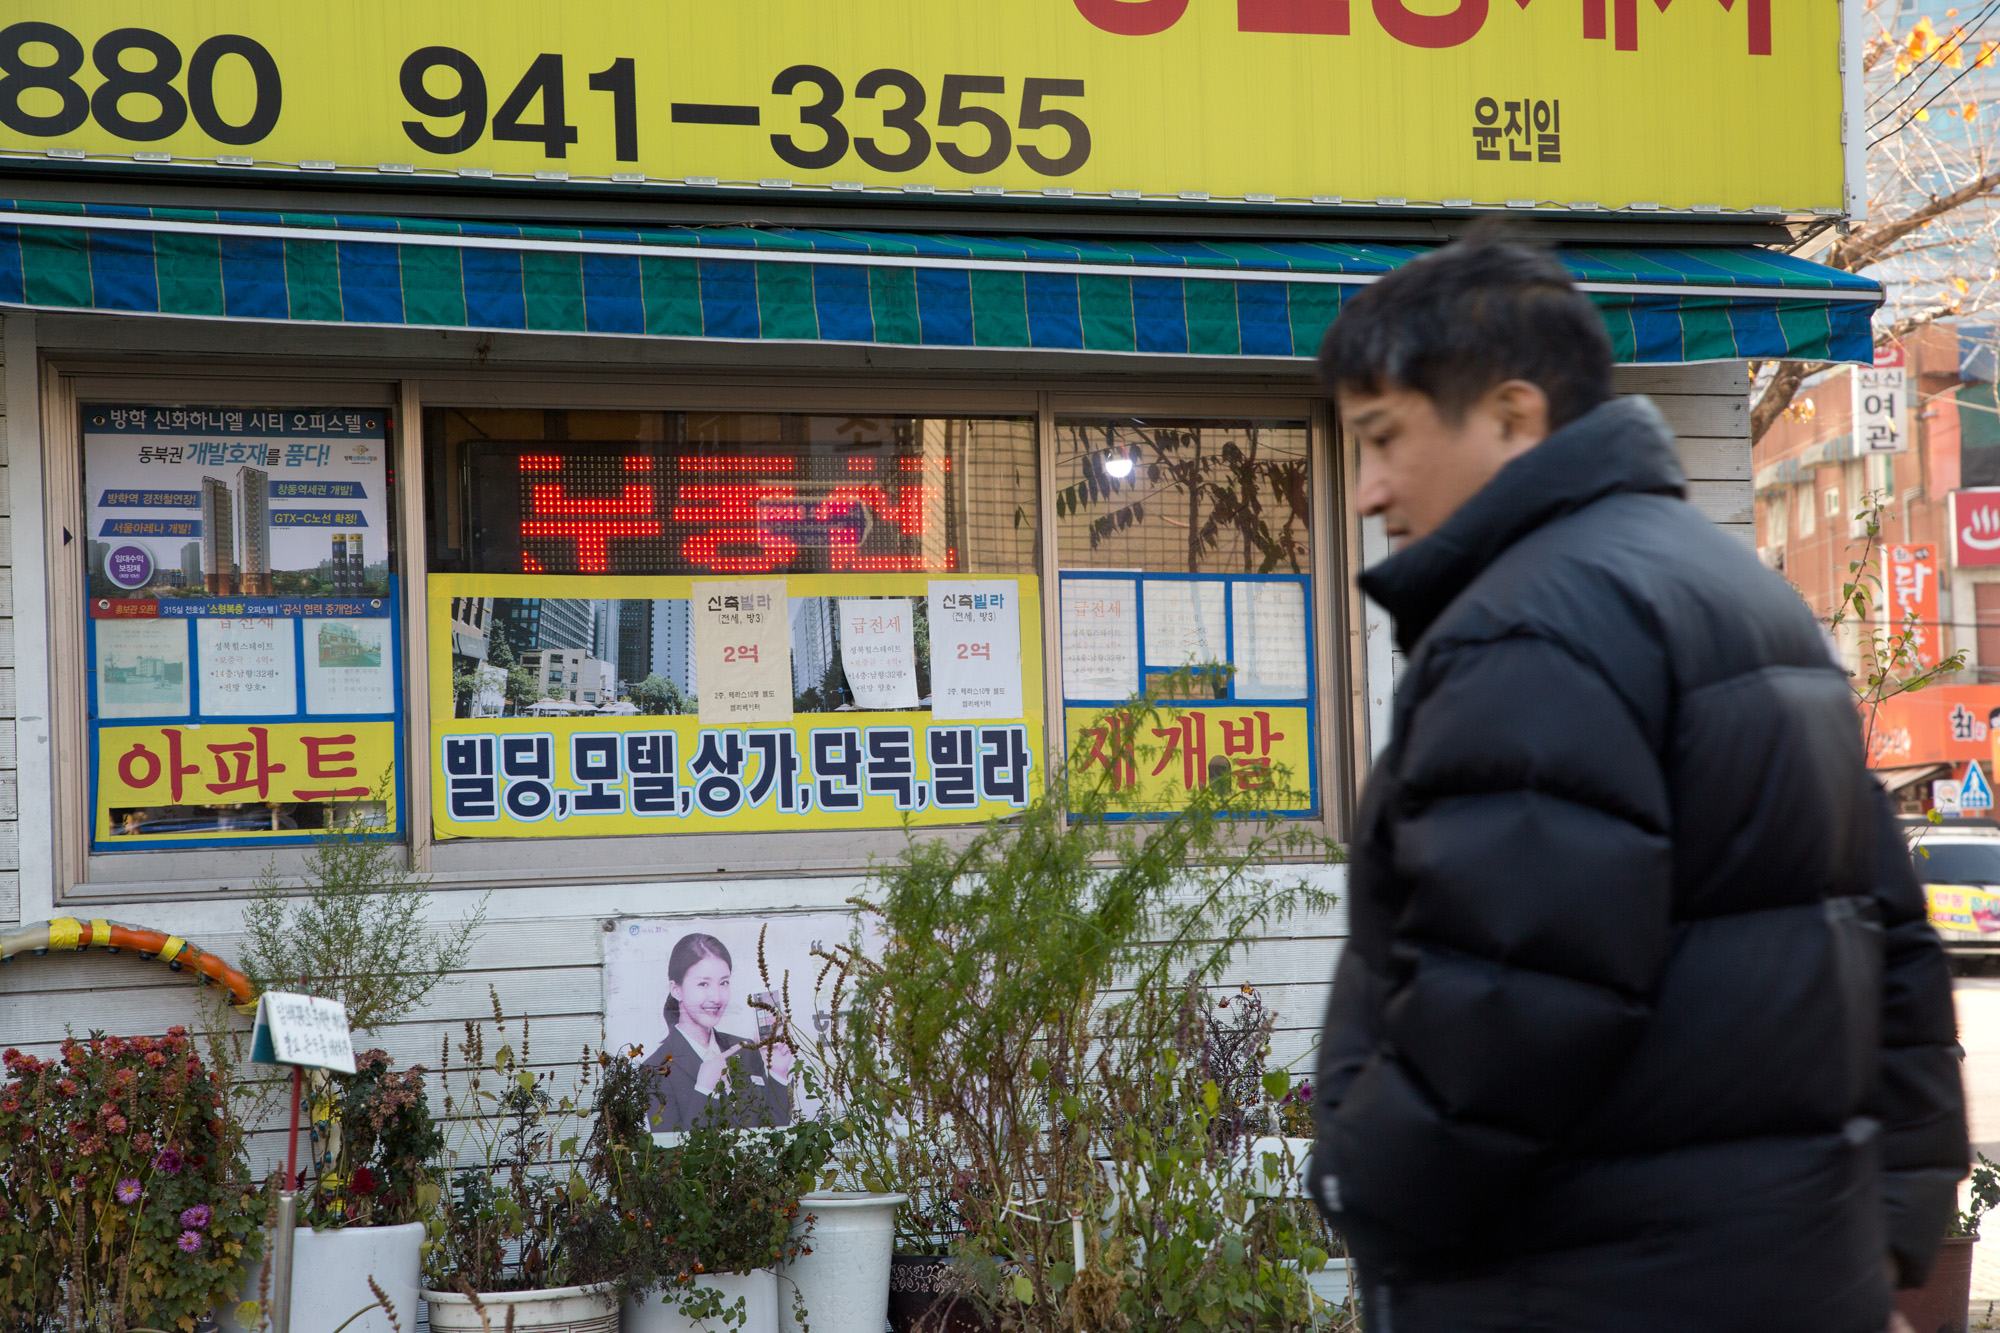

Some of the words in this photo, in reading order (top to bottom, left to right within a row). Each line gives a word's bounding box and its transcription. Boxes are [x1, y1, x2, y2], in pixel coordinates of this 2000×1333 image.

[0, 21, 282, 145] 880
[1472, 97, 1562, 163] 윤진일
[110, 409, 147, 430] 방학
[153, 411, 243, 432] 신화하니엘
[249, 413, 284, 432] 시티
[291, 414, 361, 434] 오피스텔
[1864, 393, 1900, 449] 여관
[138, 446, 184, 464] 동북권
[186, 441, 281, 466] 개발호재를
[284, 444, 331, 467] 품다!
[107, 493, 139, 505] 방학역
[143, 493, 197, 505] 경전철연장!
[277, 484, 327, 496] 창동역세권
[330, 485, 353, 496] 개발!
[274, 513, 331, 524] GTX-C노선
[334, 513, 358, 525] 확정!
[112, 522, 164, 534] 서울아레나
[168, 523, 192, 535] 개발!
[115, 555, 144, 563] 임대수익
[118, 564, 141, 573] 보장제
[164, 605, 183, 614] 315실
[247, 605, 275, 614] 오피스텔
[304, 604, 323, 615] 협력
[707, 594, 772, 611] 신축빌라
[942, 593, 1005, 610] 신축빌라
[1074, 600, 1121, 618] 급전세
[851, 616, 901, 634] 급전세
[723, 644, 759, 663] 2억
[957, 642, 990, 660] 2억
[1078, 710, 1285, 792] 재개발
[117, 727, 371, 802] 아파트
